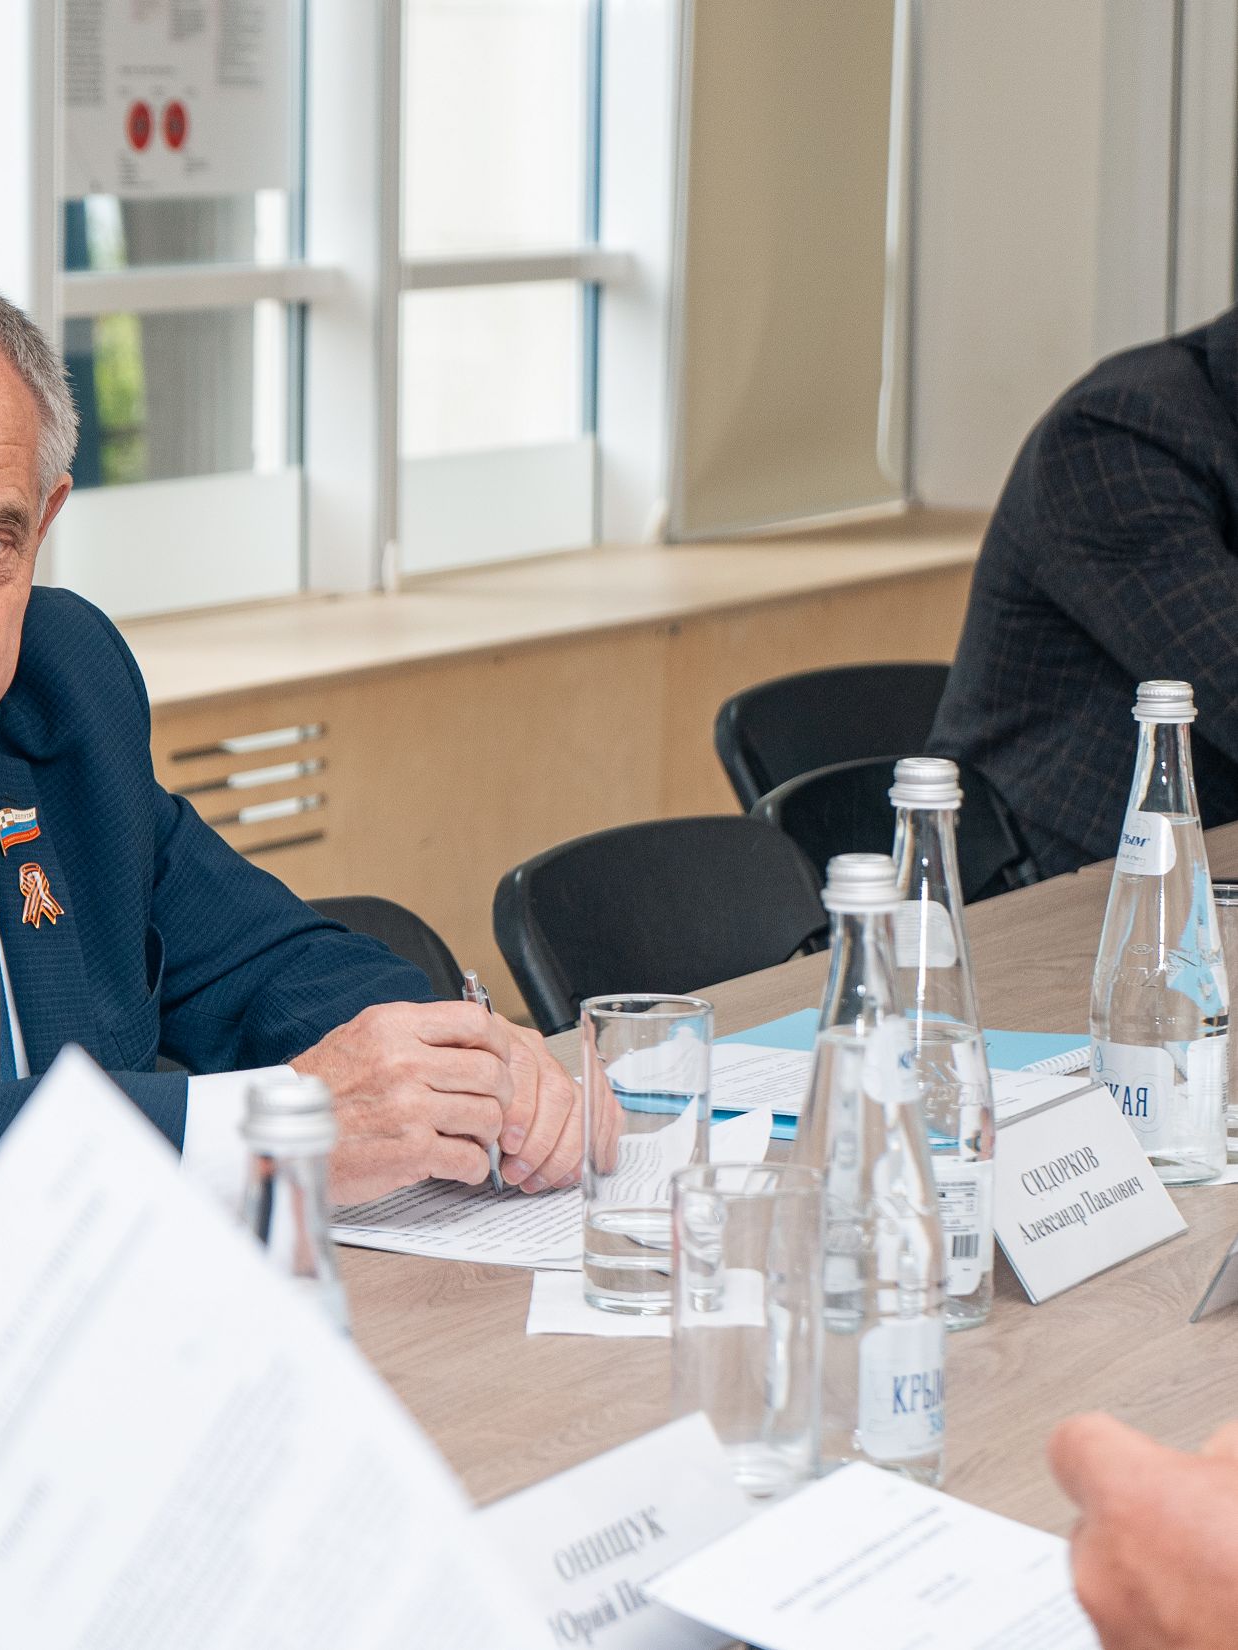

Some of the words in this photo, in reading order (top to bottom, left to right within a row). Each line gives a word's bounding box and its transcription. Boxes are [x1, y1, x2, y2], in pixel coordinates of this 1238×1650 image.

[1121, 831, 1147, 848] РЫМ
[1020, 1145, 1100, 1197] СИДОРКОВ
[1017, 1201, 1089, 1245] Александр
[1079, 1175, 1145, 1215] Павлович
[553, 1504, 666, 1582] ОНИЩУК
